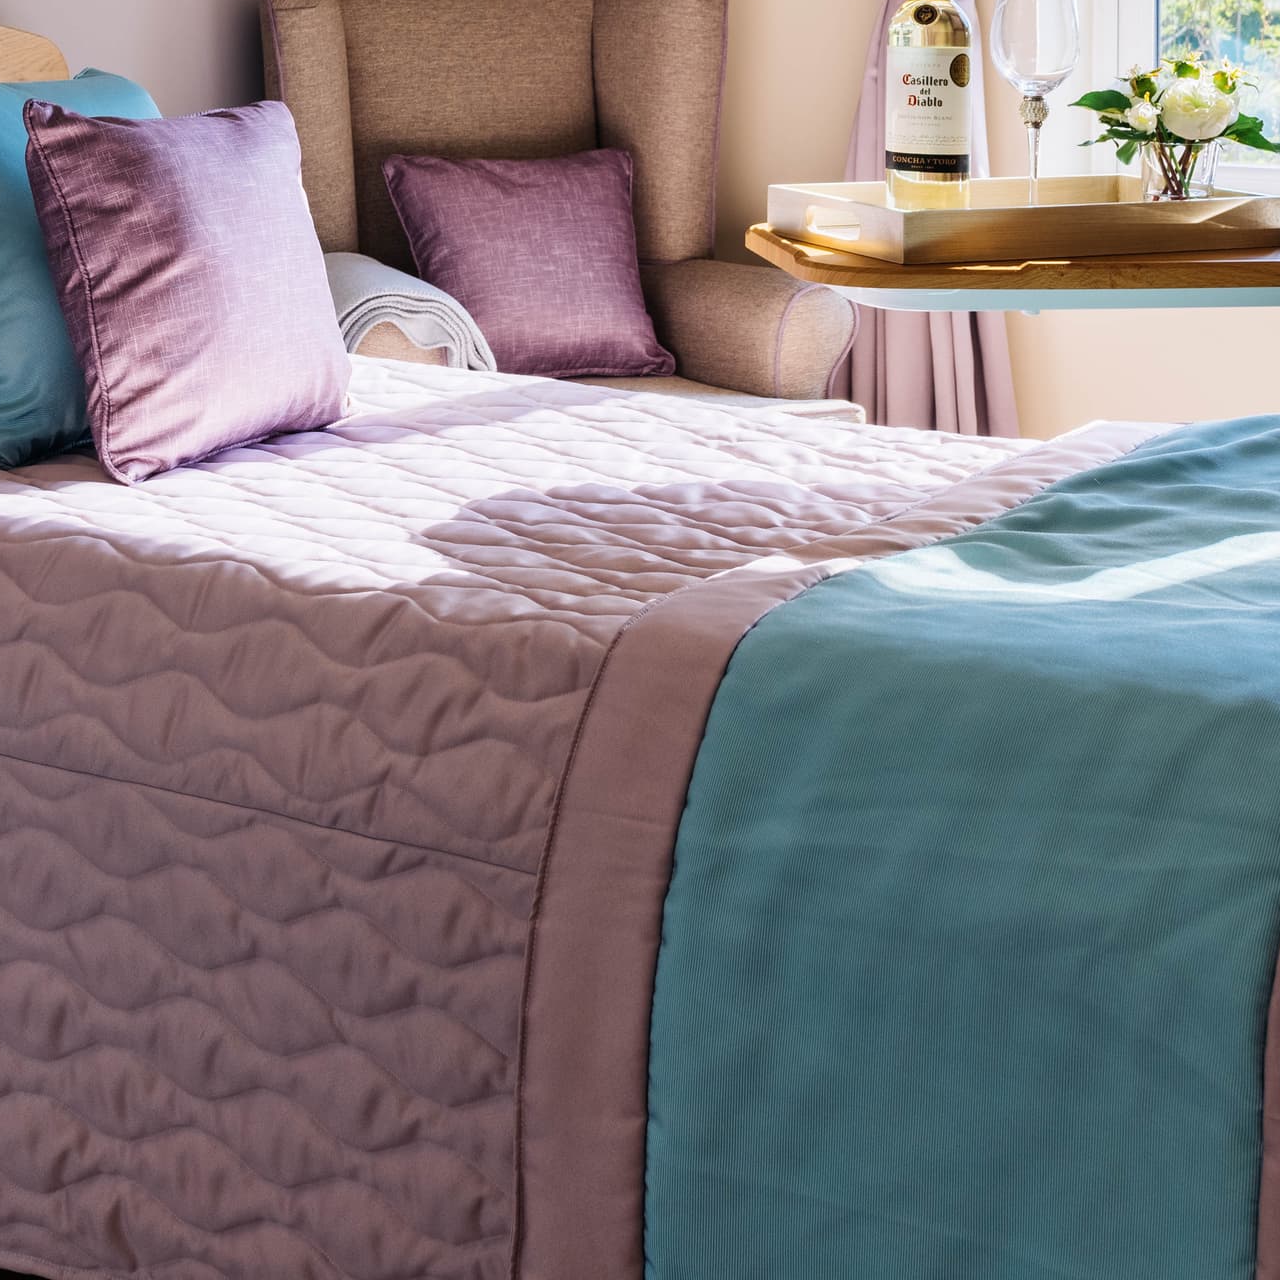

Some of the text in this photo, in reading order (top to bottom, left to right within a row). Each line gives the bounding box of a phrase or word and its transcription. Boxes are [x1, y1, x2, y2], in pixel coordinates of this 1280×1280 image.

[902, 73, 948, 87] Casillero
[907, 95, 943, 107] Diablo
[892, 155, 925, 164] CONCHA
